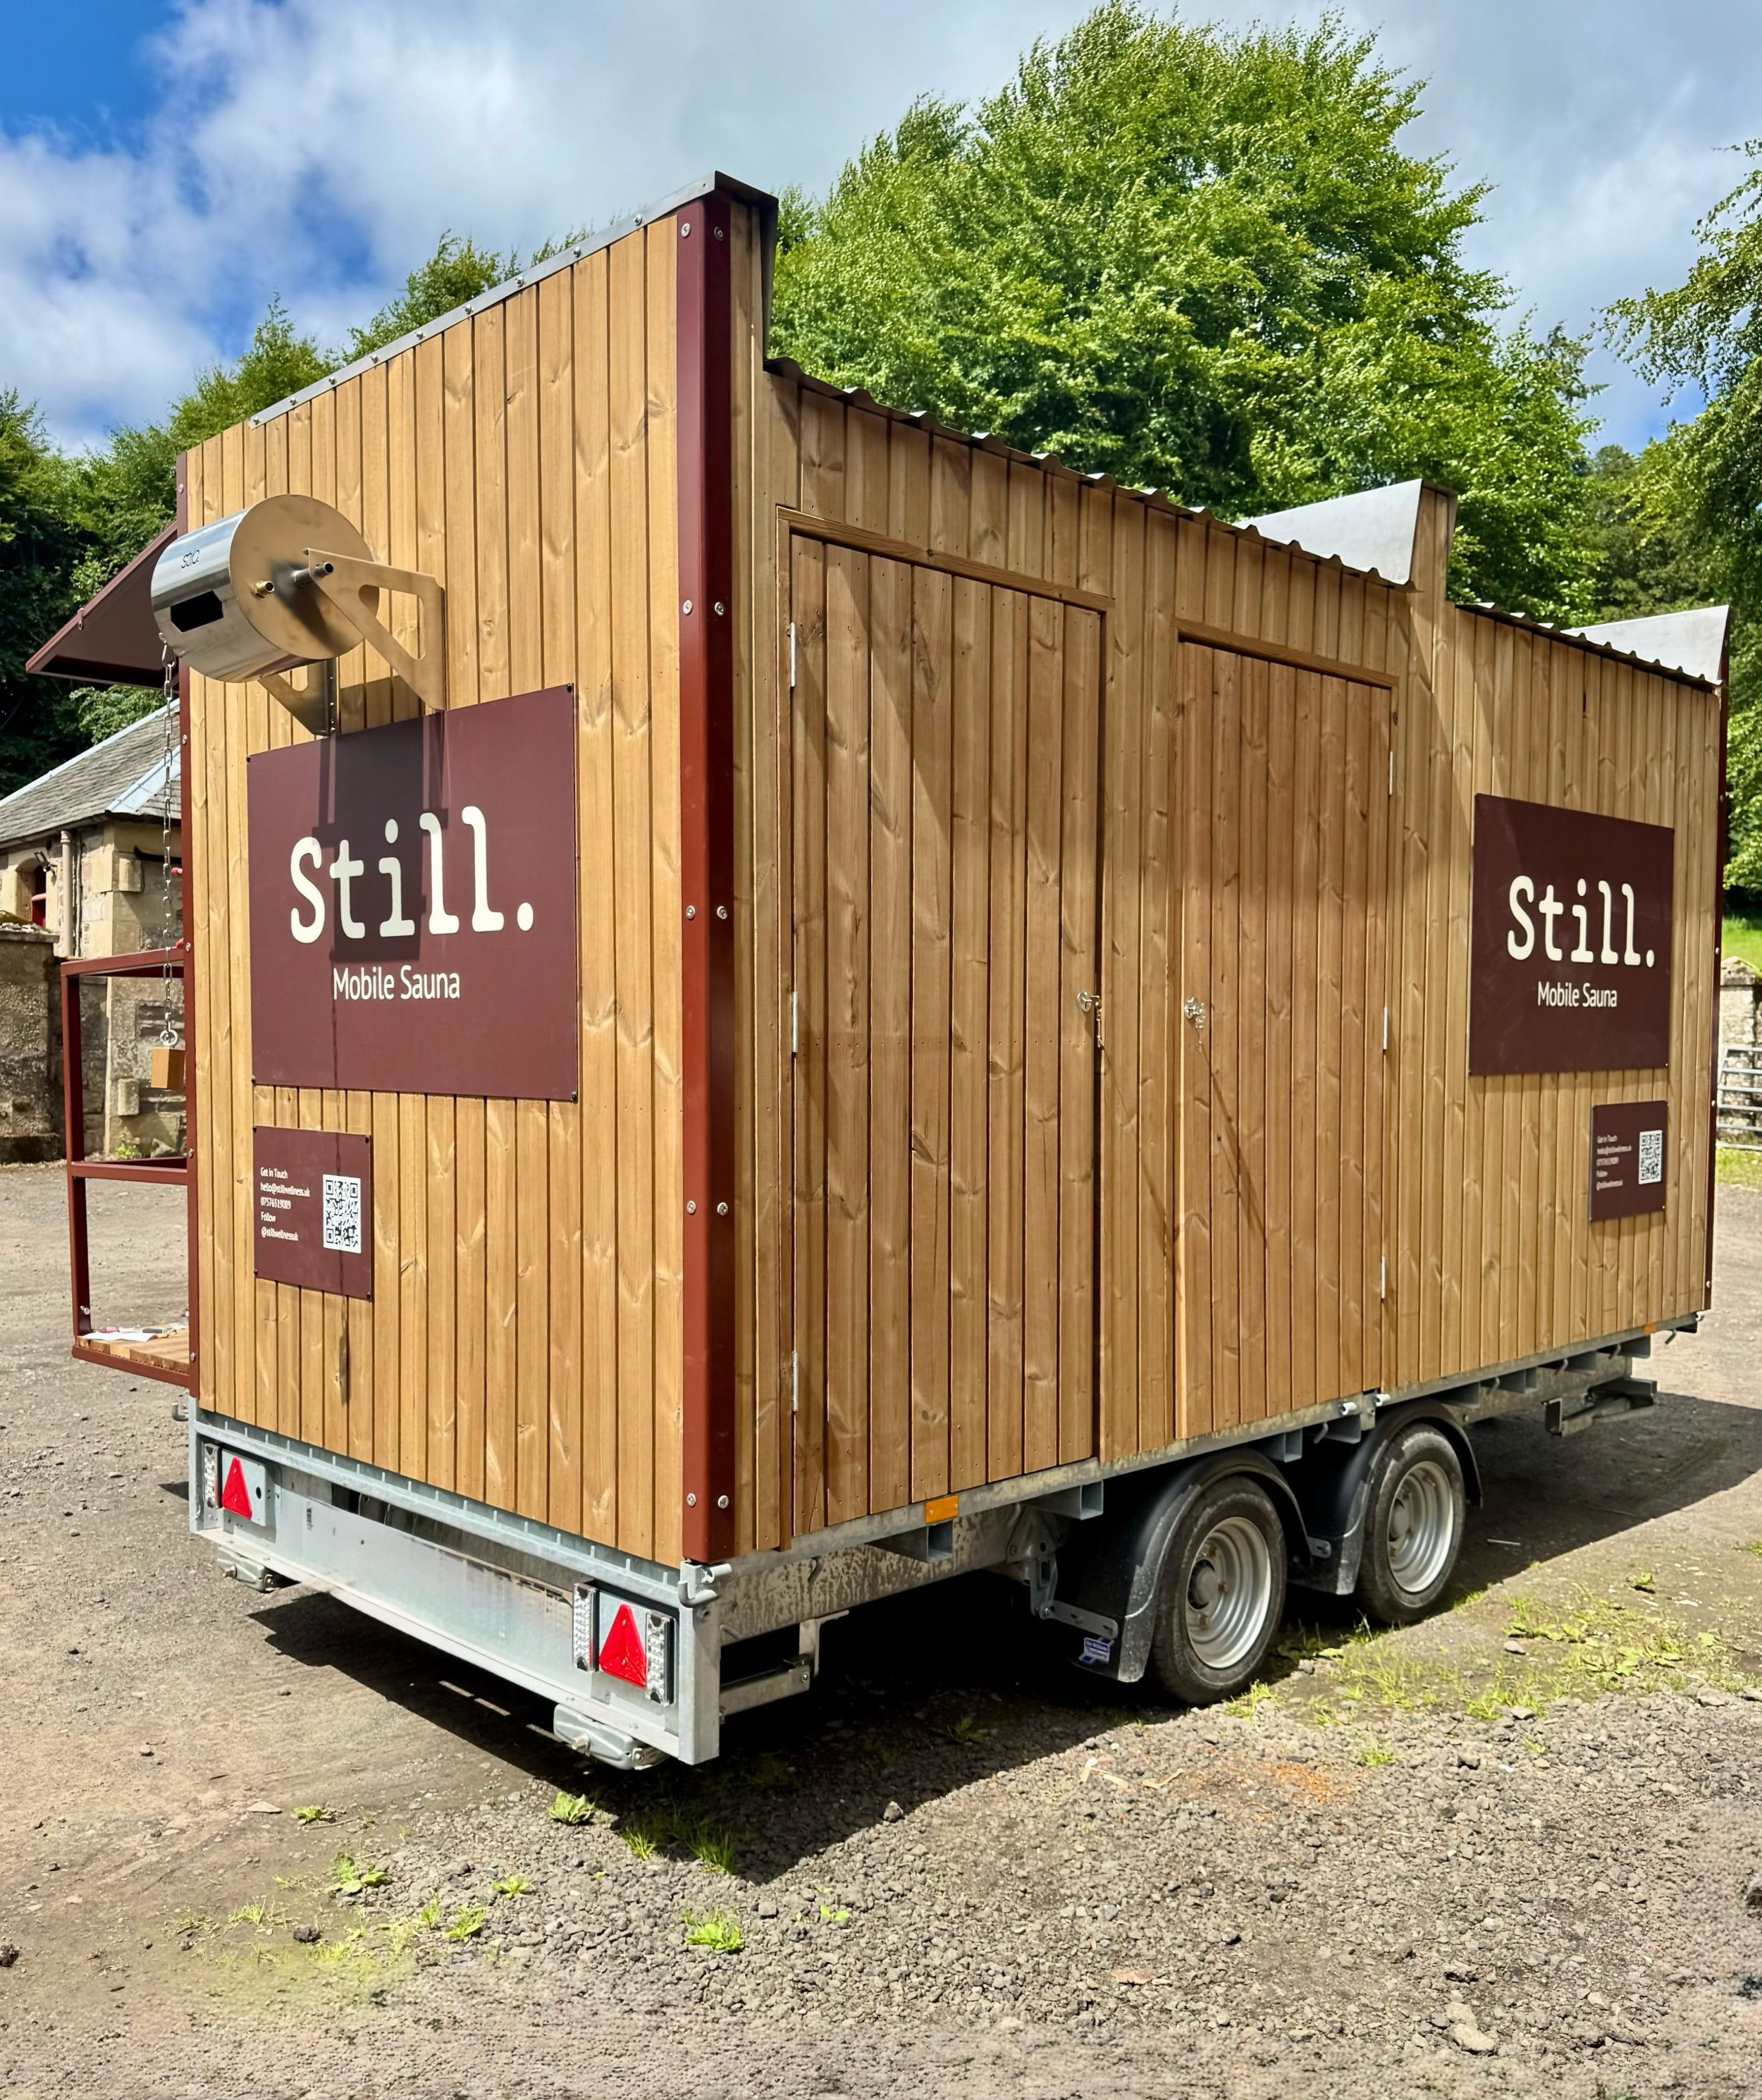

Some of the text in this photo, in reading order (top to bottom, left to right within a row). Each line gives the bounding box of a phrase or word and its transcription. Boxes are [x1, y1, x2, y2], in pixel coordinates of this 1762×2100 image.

[290, 806, 534, 944] Still.
[1508, 876, 1654, 968] Still.
[333, 964, 460, 1000] Mobile Sauna
[1537, 981, 1618, 1007] Mobile Sauna
[260, 1167, 288, 1179] Get in Touch
[260, 1211, 276, 1222] Follow
